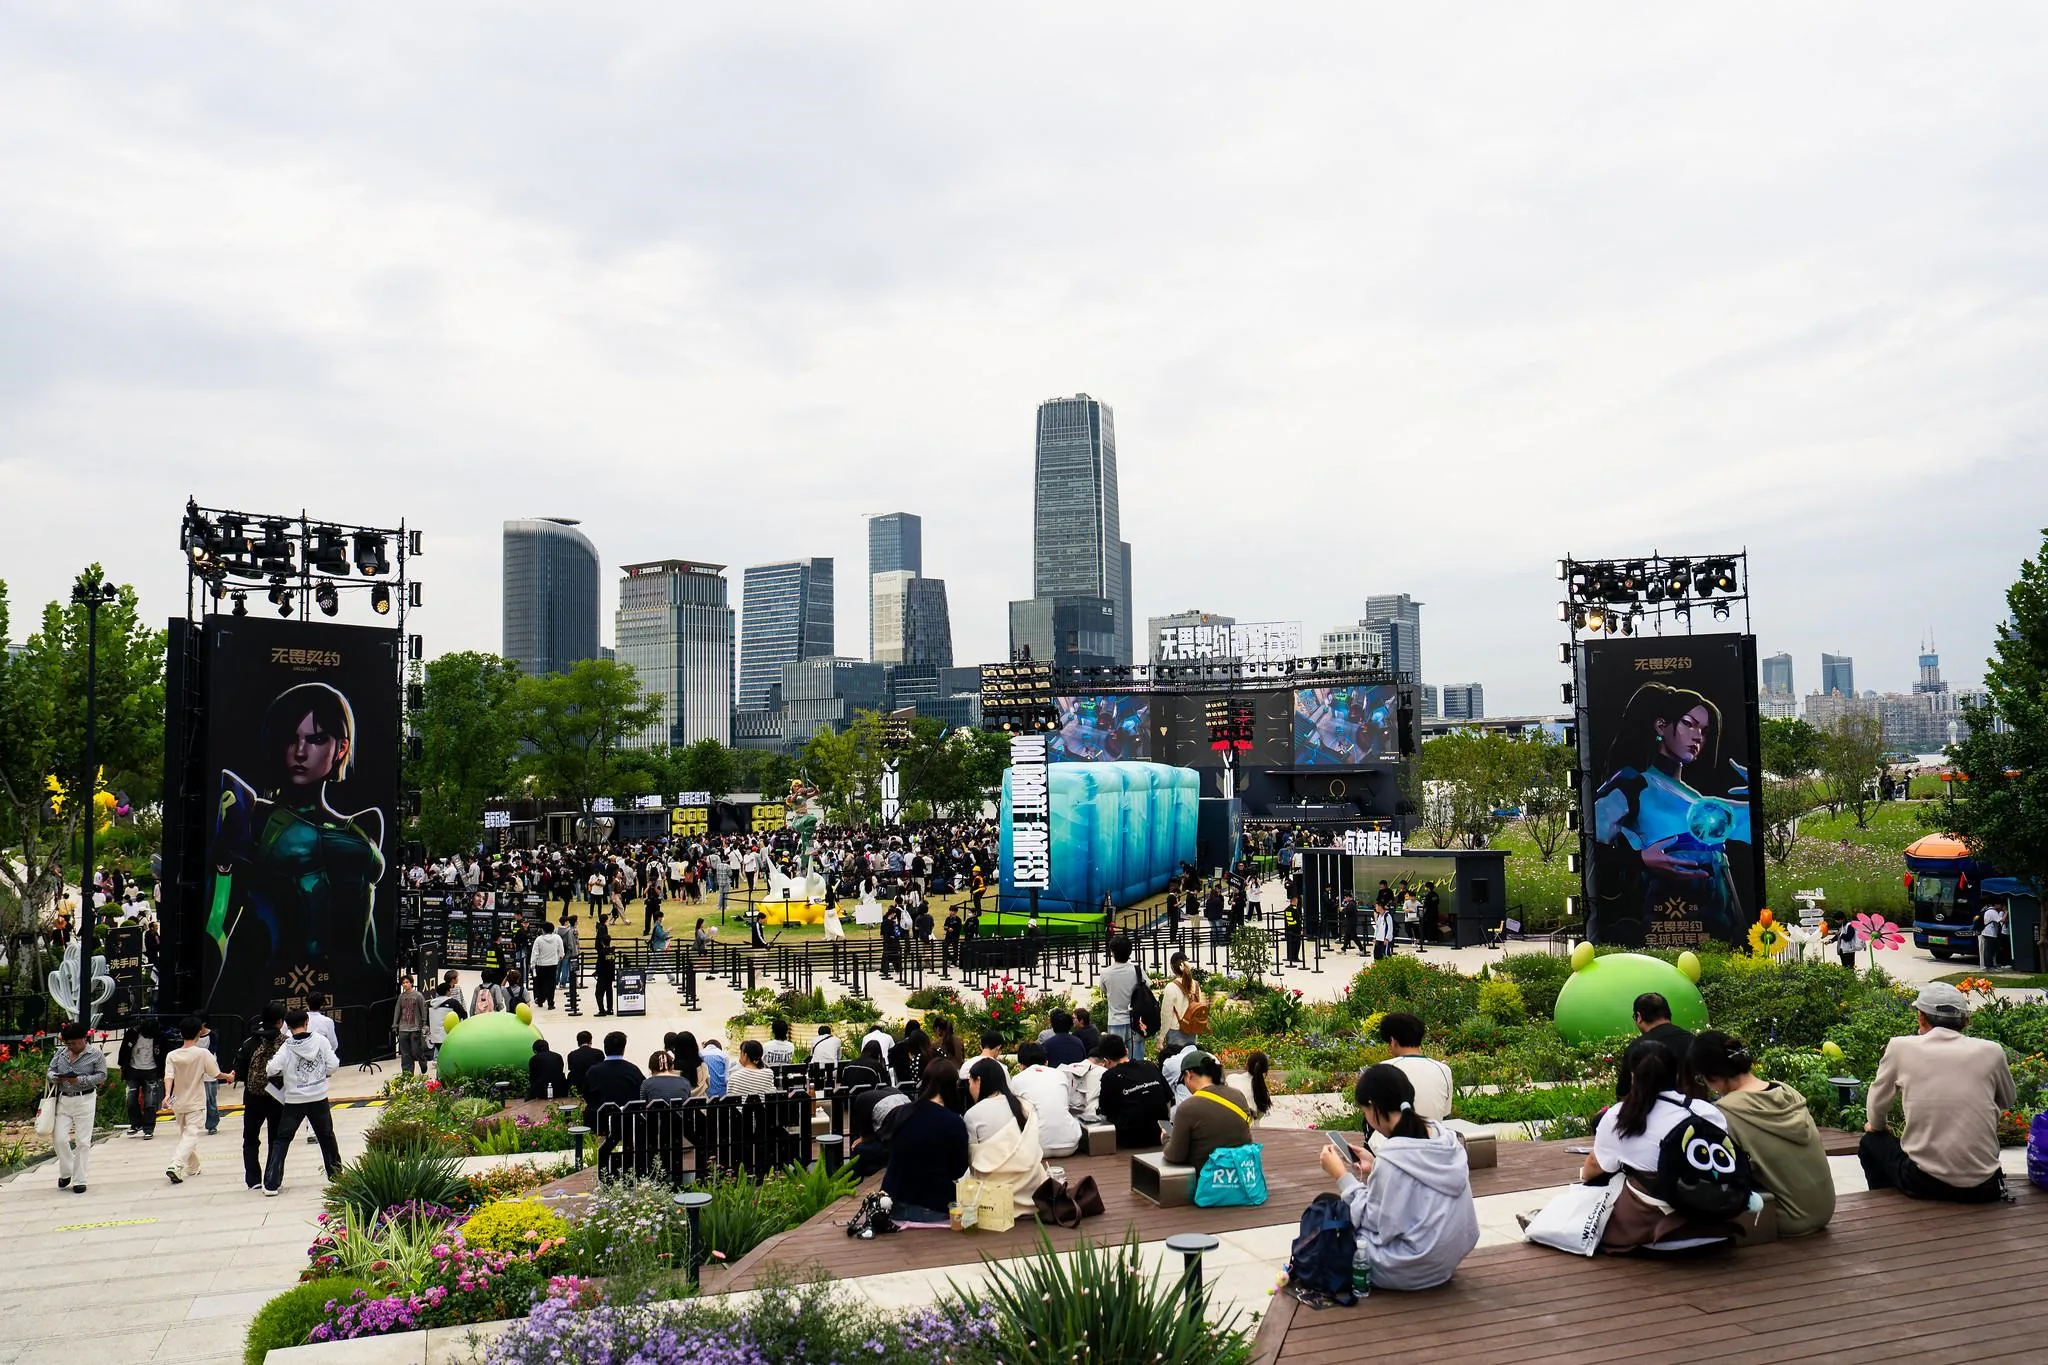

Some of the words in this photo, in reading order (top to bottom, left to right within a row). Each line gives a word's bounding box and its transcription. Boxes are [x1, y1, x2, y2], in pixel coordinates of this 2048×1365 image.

[271, 648, 340, 666] 无畏契约
[1634, 657, 1692, 670] 无畏契约
[1653, 904, 1663, 912] 20
[1651, 920, 1703, 933] 无畏契约
[110, 956, 139, 970] 洗手间
[274, 976, 286, 986] 20
[318, 972, 329, 981] 26
[422, 977, 436, 993] 入口
